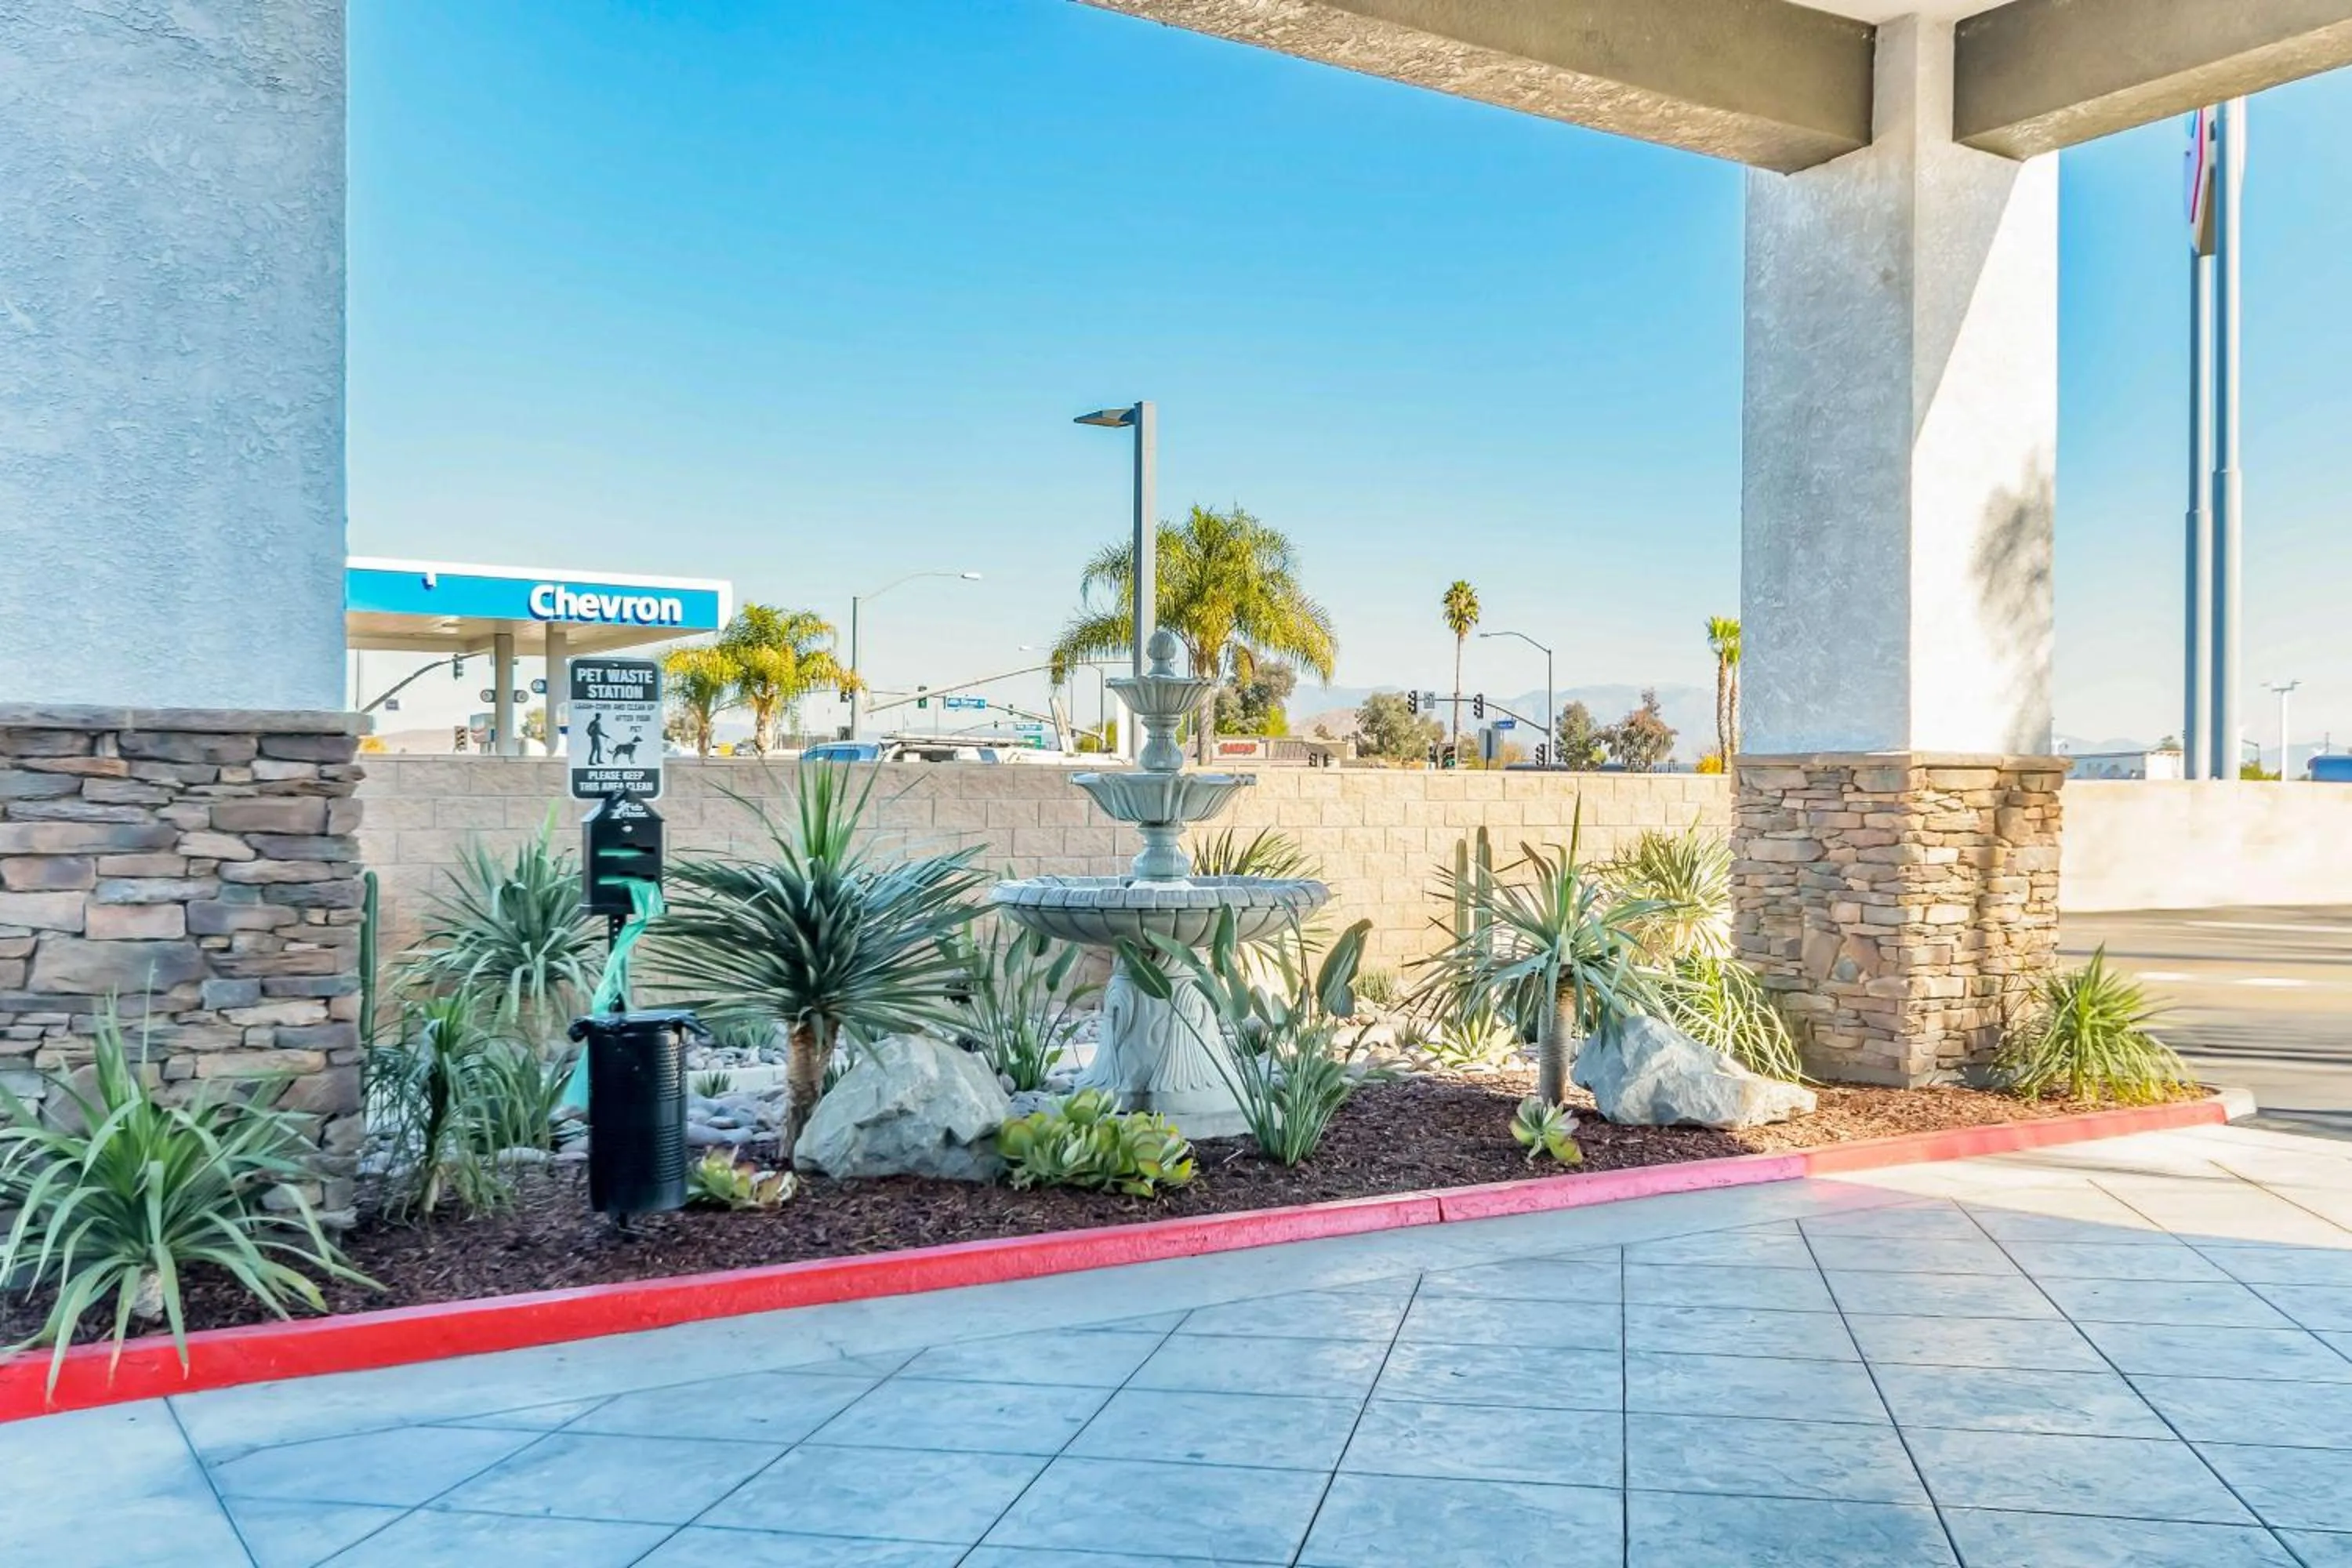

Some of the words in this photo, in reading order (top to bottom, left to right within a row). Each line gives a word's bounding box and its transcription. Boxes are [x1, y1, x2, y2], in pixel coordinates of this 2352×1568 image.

[528, 583, 683, 623] Chevron
[576, 667, 604, 682] PET
[606, 669, 653, 684] WASTE
[587, 684, 643, 699] STATION
[587, 771, 621, 780] PLEASE
[622, 771, 645, 780] KEEP
[579, 782, 600, 791] THIS
[601, 782, 624, 791] AREA
[626, 782, 654, 791] CLEAN
